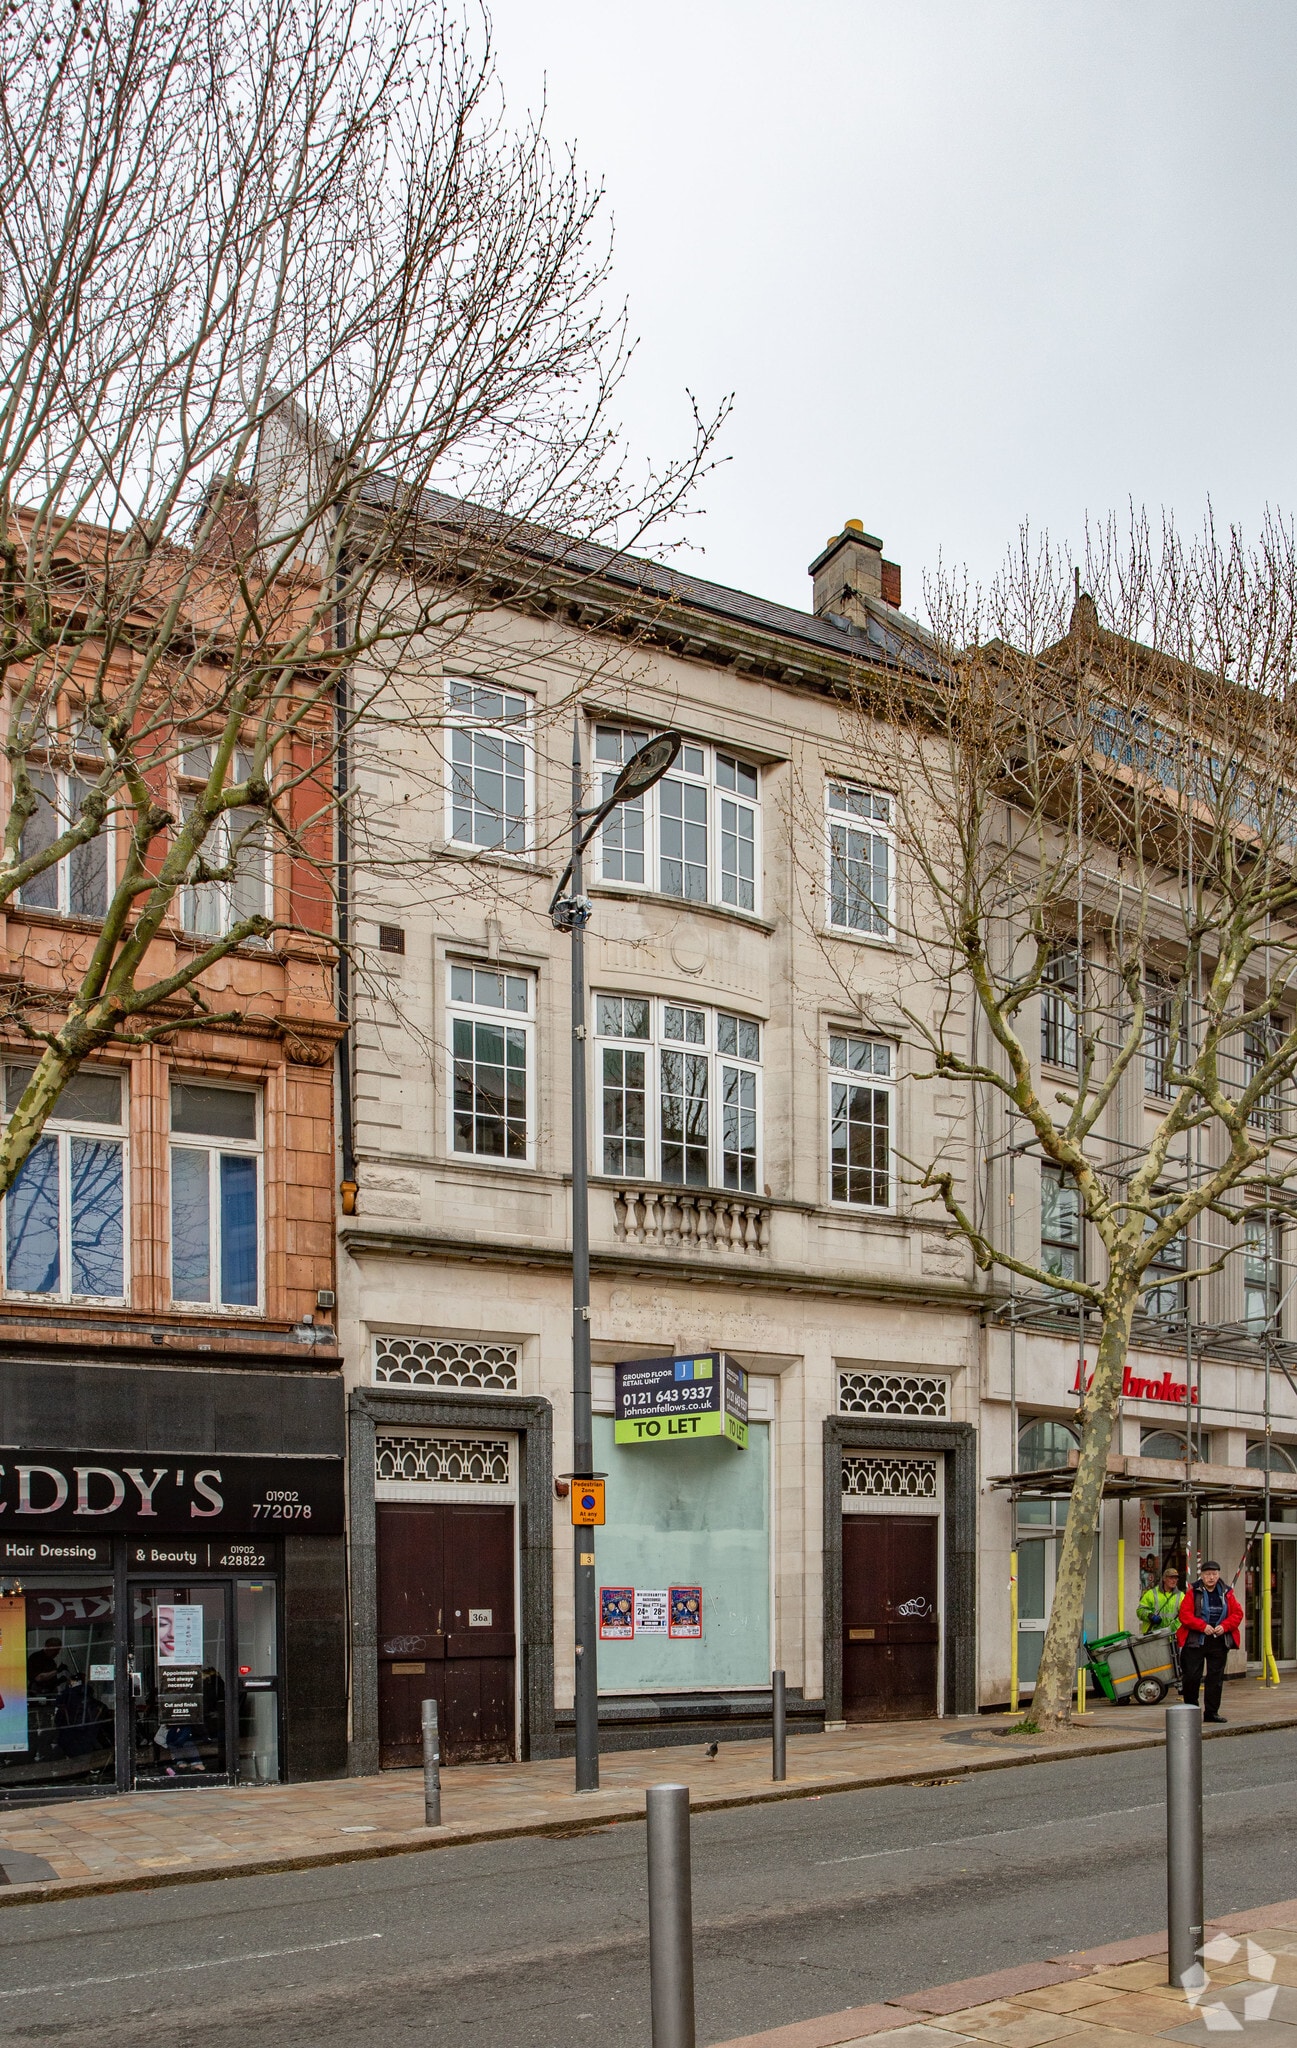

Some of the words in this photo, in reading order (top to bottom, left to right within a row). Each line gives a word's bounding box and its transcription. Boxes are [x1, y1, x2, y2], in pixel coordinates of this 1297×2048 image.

[622, 1379, 643, 1387] RETAIL
[644, 1377, 660, 1385] UNIT
[623, 1372, 651, 1381] GROUND
[651, 1370, 673, 1378] FLOOR
[1074, 1359, 1198, 1404] Lbrokes
[622, 1392, 651, 1406] 0121
[656, 1389, 679, 1403] 643
[681, 1386, 713, 1400] 9337
[624, 1400, 712, 1418] johnsonfellows.co.uk
[634, 1420, 661, 1437] TO
[668, 1417, 701, 1435] LET
[729, 1418, 736, 1437] TO
[736, 1423, 745, 1442] LET
[0, 1464, 224, 1518] DDY'S
[266, 1491, 299, 1502] 01902
[252, 1504, 312, 1519] 772078
[6, 1544, 35, 1557] Hair
[40, 1544, 97, 1560] Dressing
[136, 1549, 146, 1561] &
[151, 1549, 197, 1565] Beauty
[230, 1546, 255, 1554] 01902
[220, 1555, 266, 1566] 428822
[472, 1613, 488, 1621] 36a
